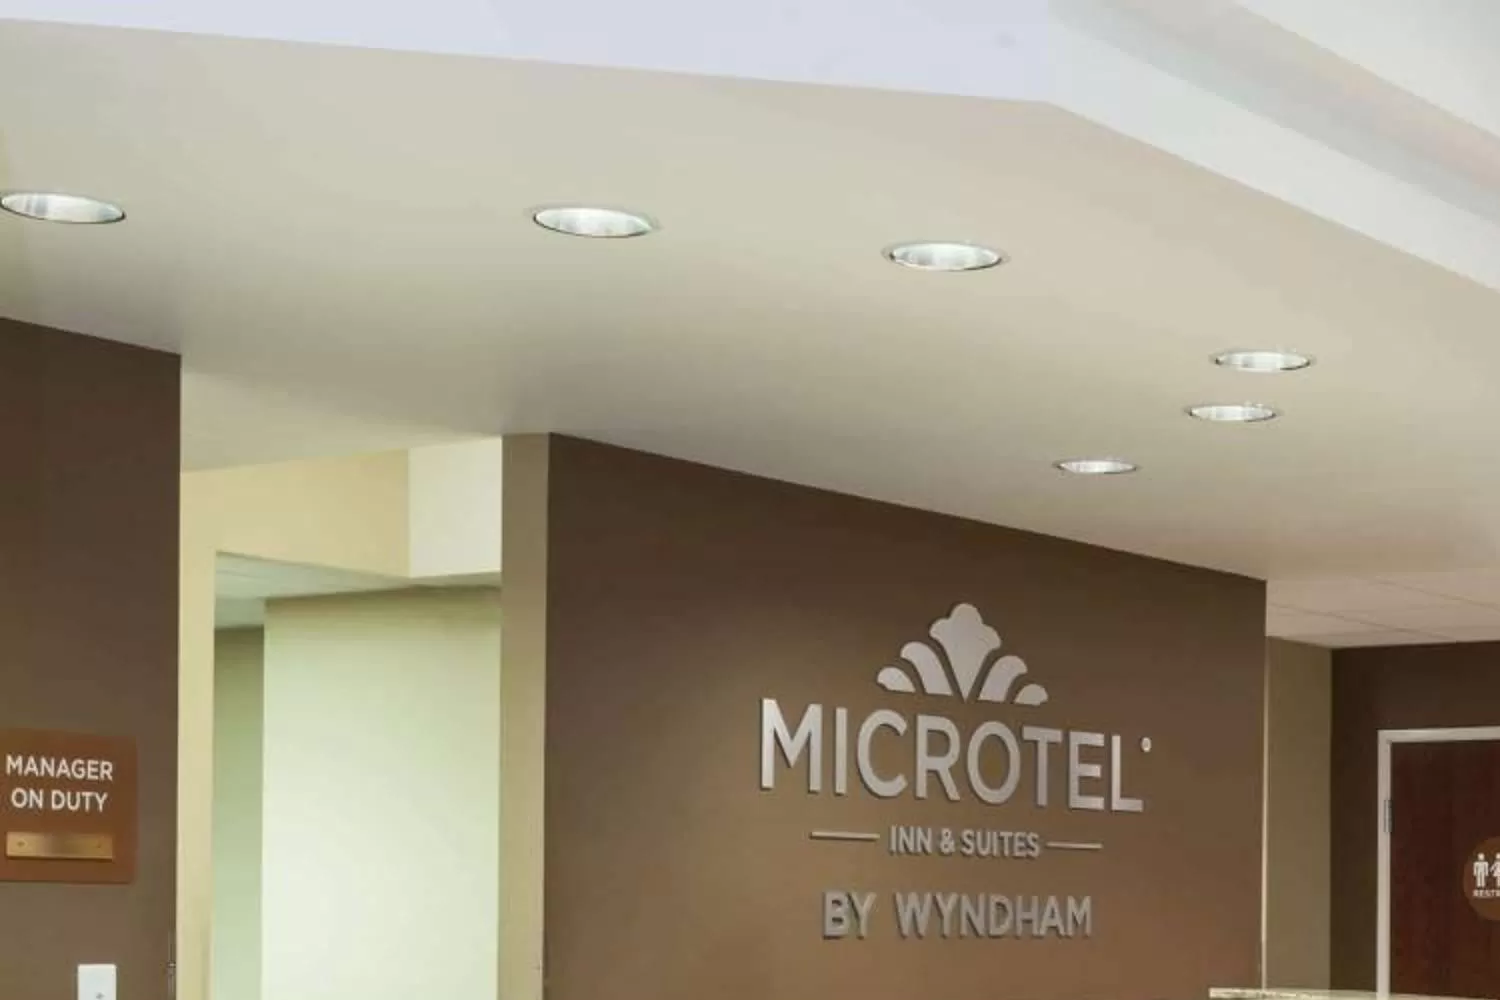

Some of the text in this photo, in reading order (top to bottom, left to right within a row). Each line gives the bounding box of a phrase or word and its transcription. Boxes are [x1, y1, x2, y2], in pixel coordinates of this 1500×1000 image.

[5, 754, 114, 782] MANAGER
[760, 697, 1144, 812] MICROTEL
[11, 788, 109, 812] ON DUTY
[890, 825, 1040, 859] INN & SUITES
[823, 890, 1092, 938] BY WYNDHAM
